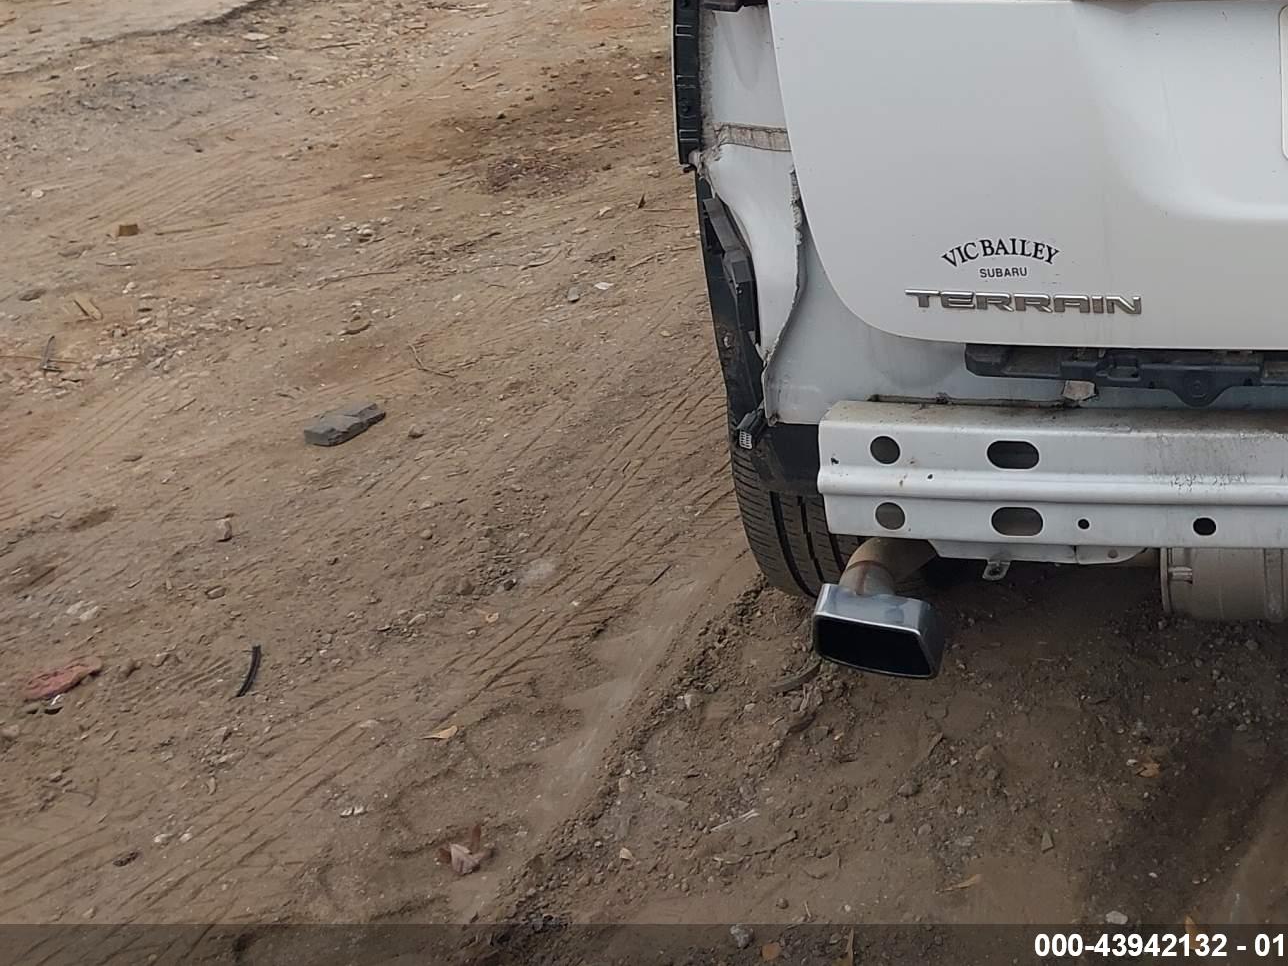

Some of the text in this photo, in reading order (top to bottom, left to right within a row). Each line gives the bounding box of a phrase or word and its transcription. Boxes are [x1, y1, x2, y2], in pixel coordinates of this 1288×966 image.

[941, 237, 1061, 268] VIC BAILEY
[979, 266, 1028, 278] SUBARU
[904, 288, 1142, 315] TERRAIN
